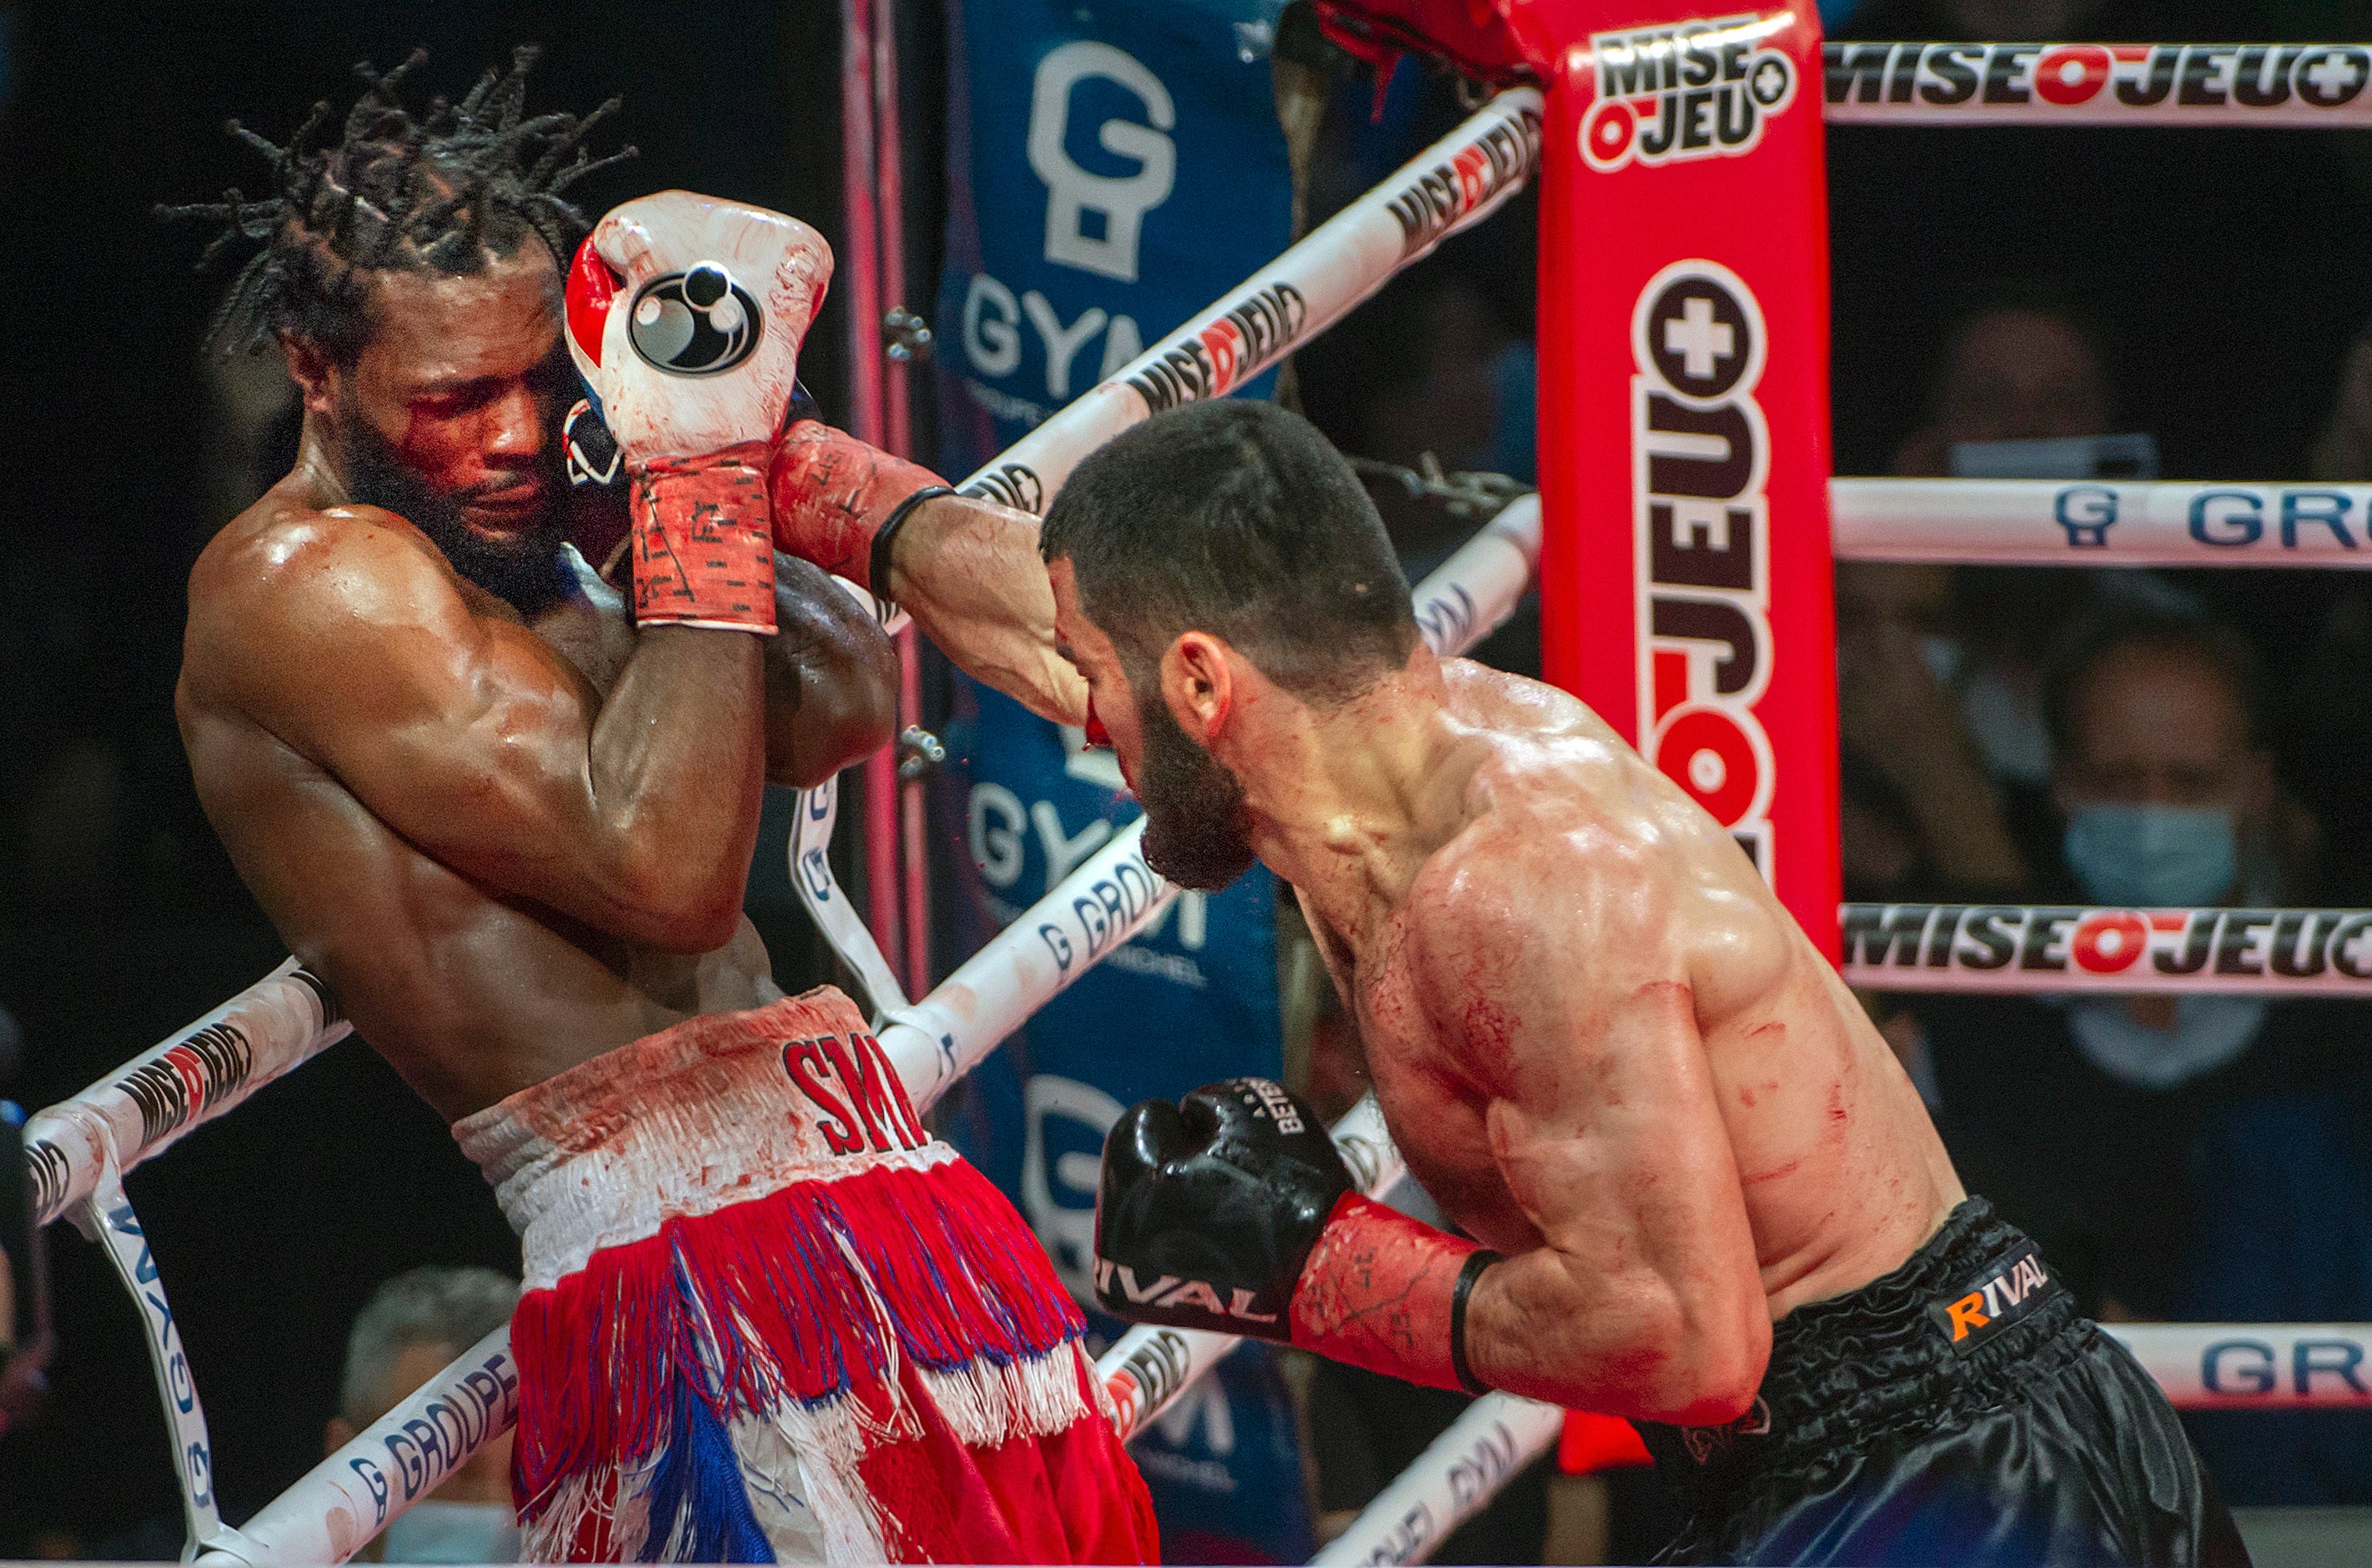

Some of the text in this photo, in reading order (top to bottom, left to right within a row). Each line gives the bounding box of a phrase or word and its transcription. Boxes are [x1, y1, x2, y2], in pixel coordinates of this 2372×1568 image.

[1601, 17, 1756, 98] MISE
[2188, 489, 2372, 548] GR
[1093, 1257, 1277, 1324] IVAL
[1945, 1253, 2049, 1342] RIVAL
